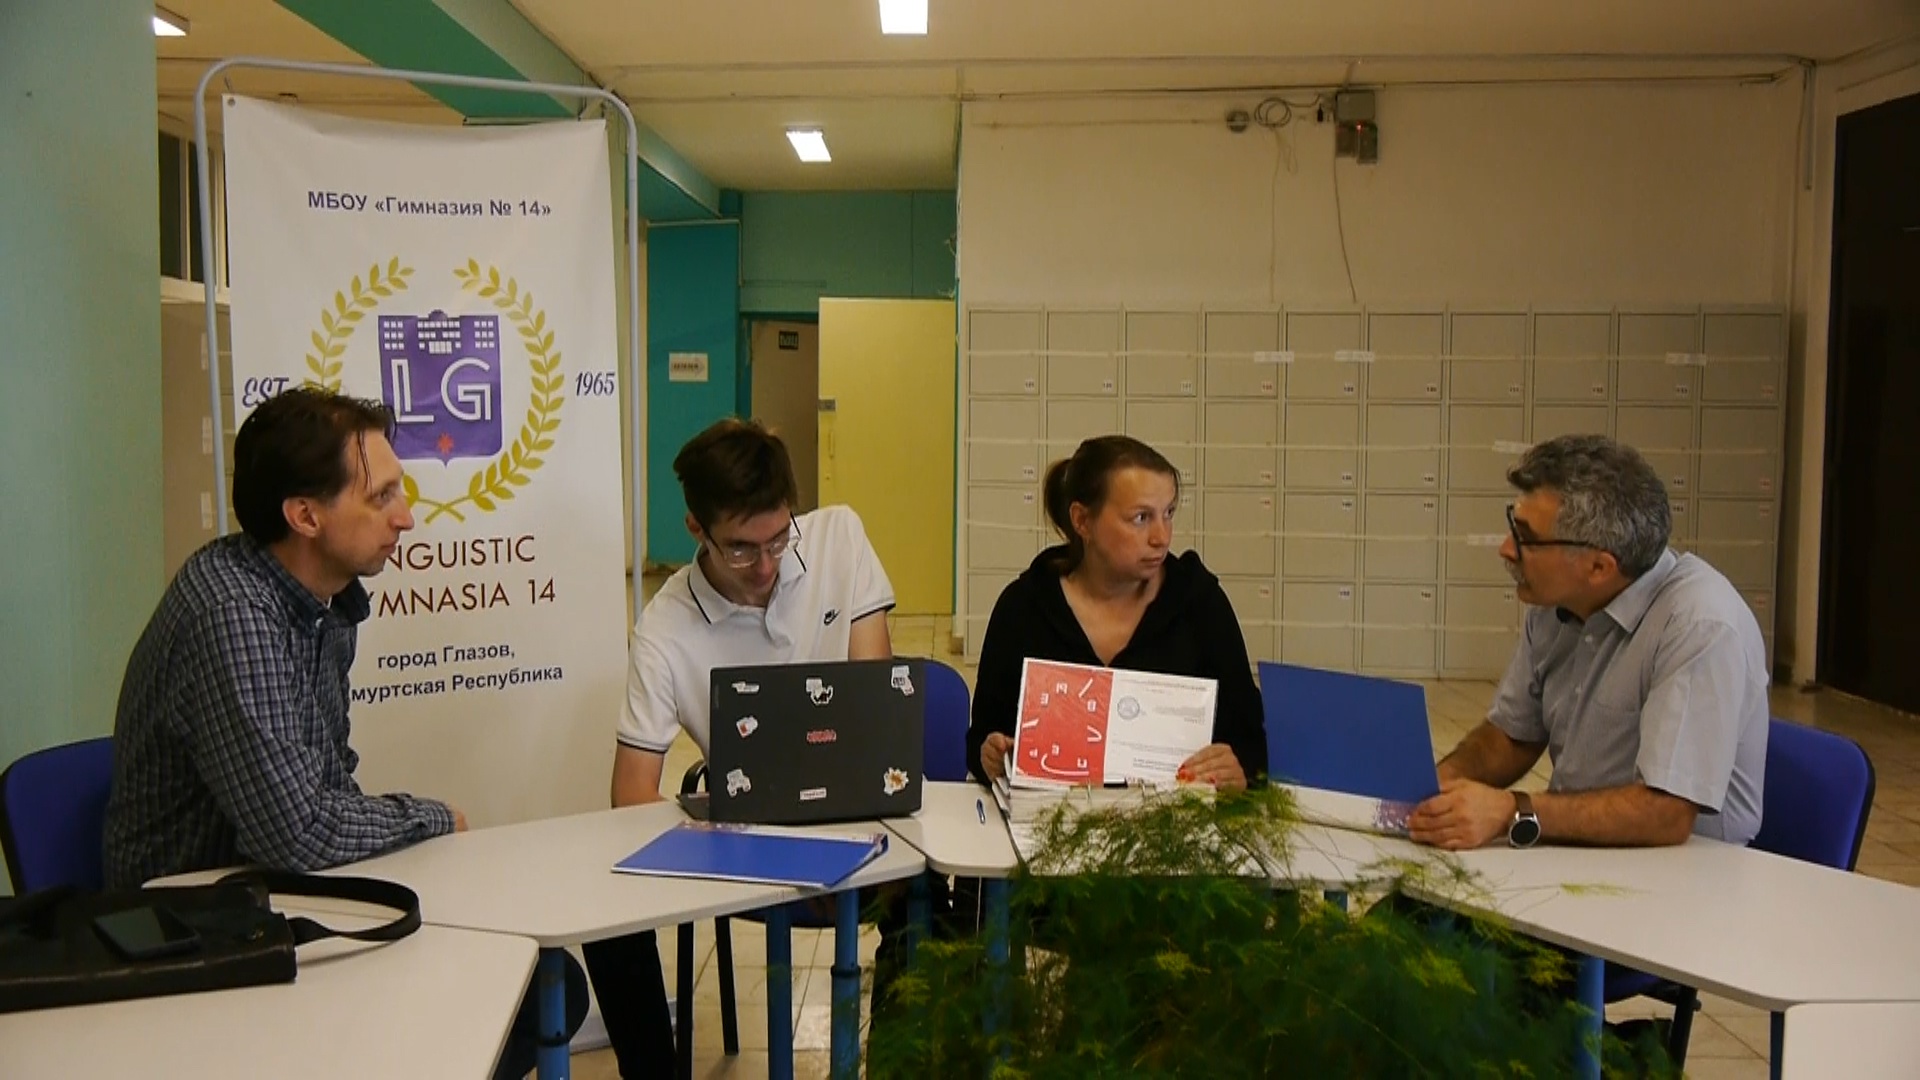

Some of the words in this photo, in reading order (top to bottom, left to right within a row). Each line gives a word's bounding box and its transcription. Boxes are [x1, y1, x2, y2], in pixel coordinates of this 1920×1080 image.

[307, 190, 367, 211] МБОУ
[374, 196, 483, 216] «Гимназия
[489, 199, 512, 216] №
[518, 200, 551, 217] 14»
[574, 371, 616, 397] 1965
[369, 580, 510, 618] MNASIA
[528, 577, 556, 605] 14
[377, 651, 438, 671] город
[442, 644, 516, 666] Глазов,
[451, 666, 563, 693] Республика
